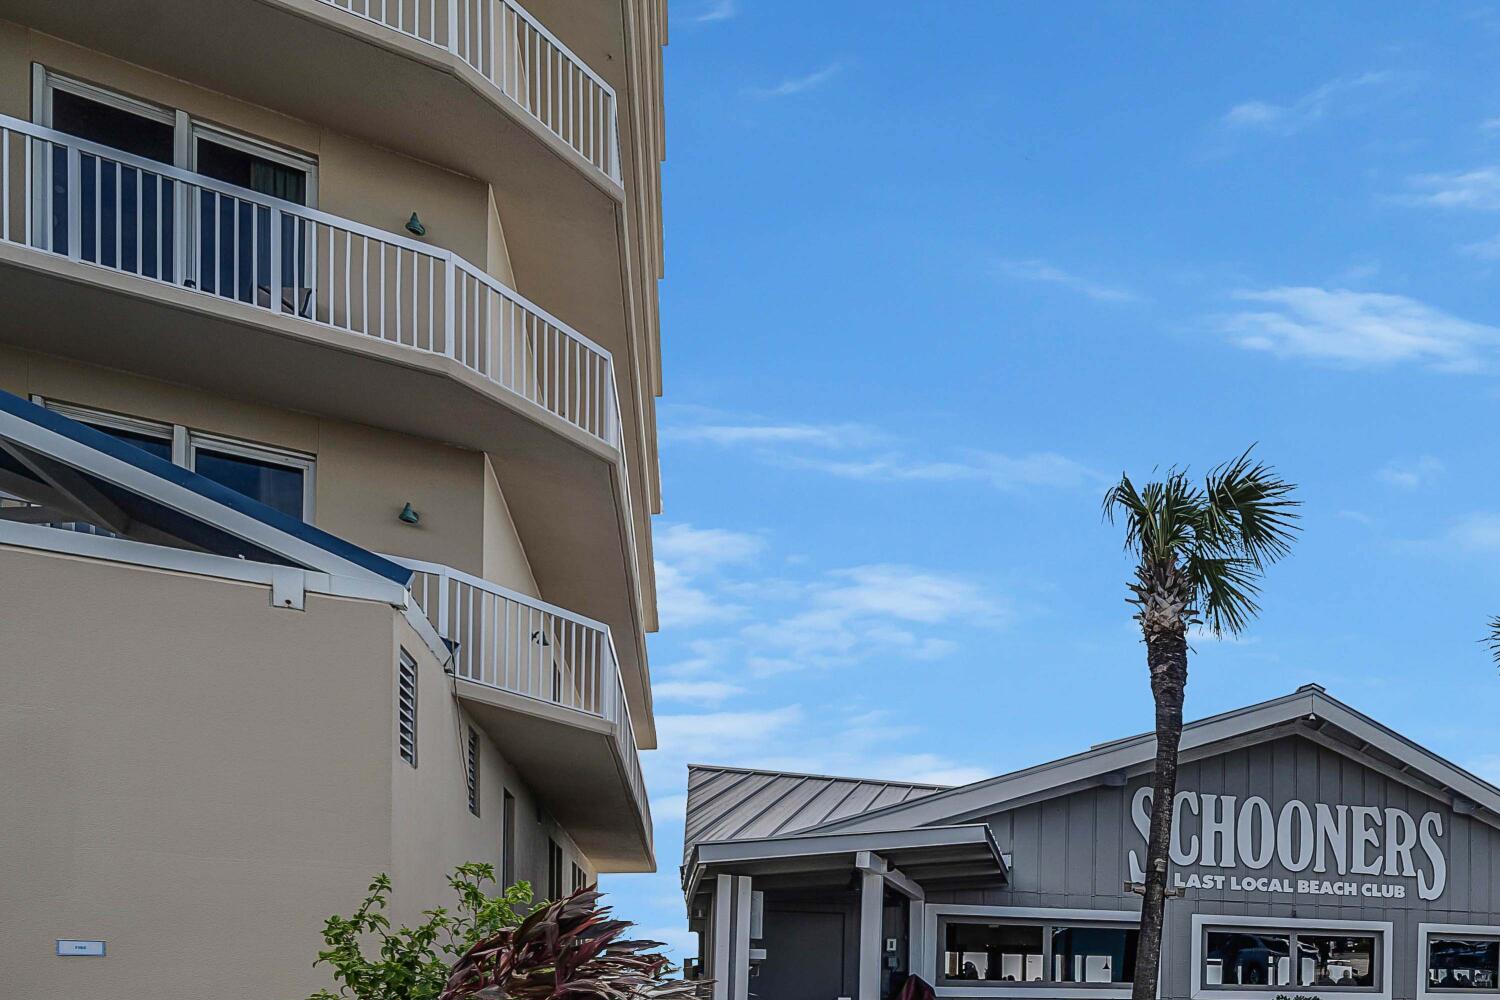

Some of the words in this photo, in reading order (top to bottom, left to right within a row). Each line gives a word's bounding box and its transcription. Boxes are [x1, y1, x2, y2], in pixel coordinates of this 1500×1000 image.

[1174, 872, 1226, 890] LAST
[1230, 876, 1294, 893] LOCAL
[1297, 879, 1358, 896] BEACH
[1361, 883, 1406, 899] CLUB
